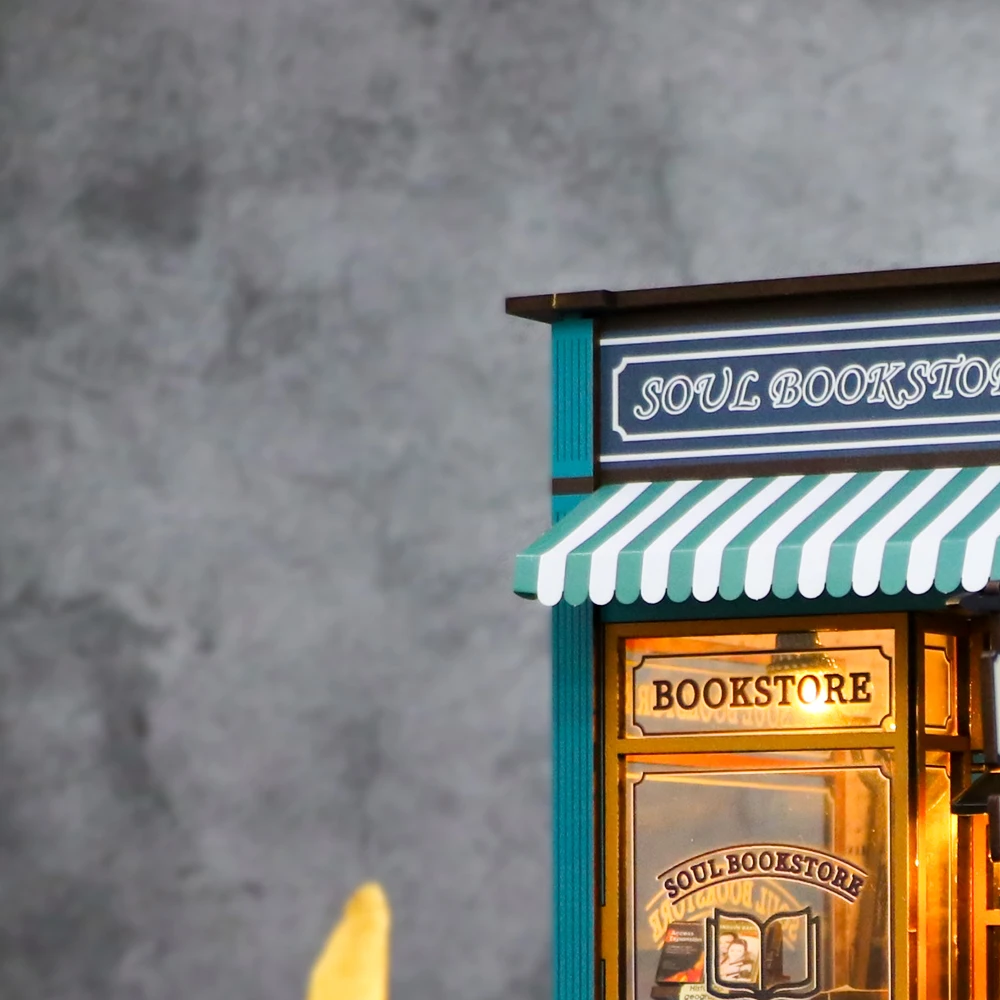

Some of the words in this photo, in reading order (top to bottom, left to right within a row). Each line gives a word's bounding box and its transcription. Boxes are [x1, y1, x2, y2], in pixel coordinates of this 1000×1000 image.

[633, 367, 761, 421] SOUL
[653, 672, 872, 711] BOOKSTORE
[664, 860, 723, 899] SOUL
[726, 852, 864, 898] BOOKSTORE
